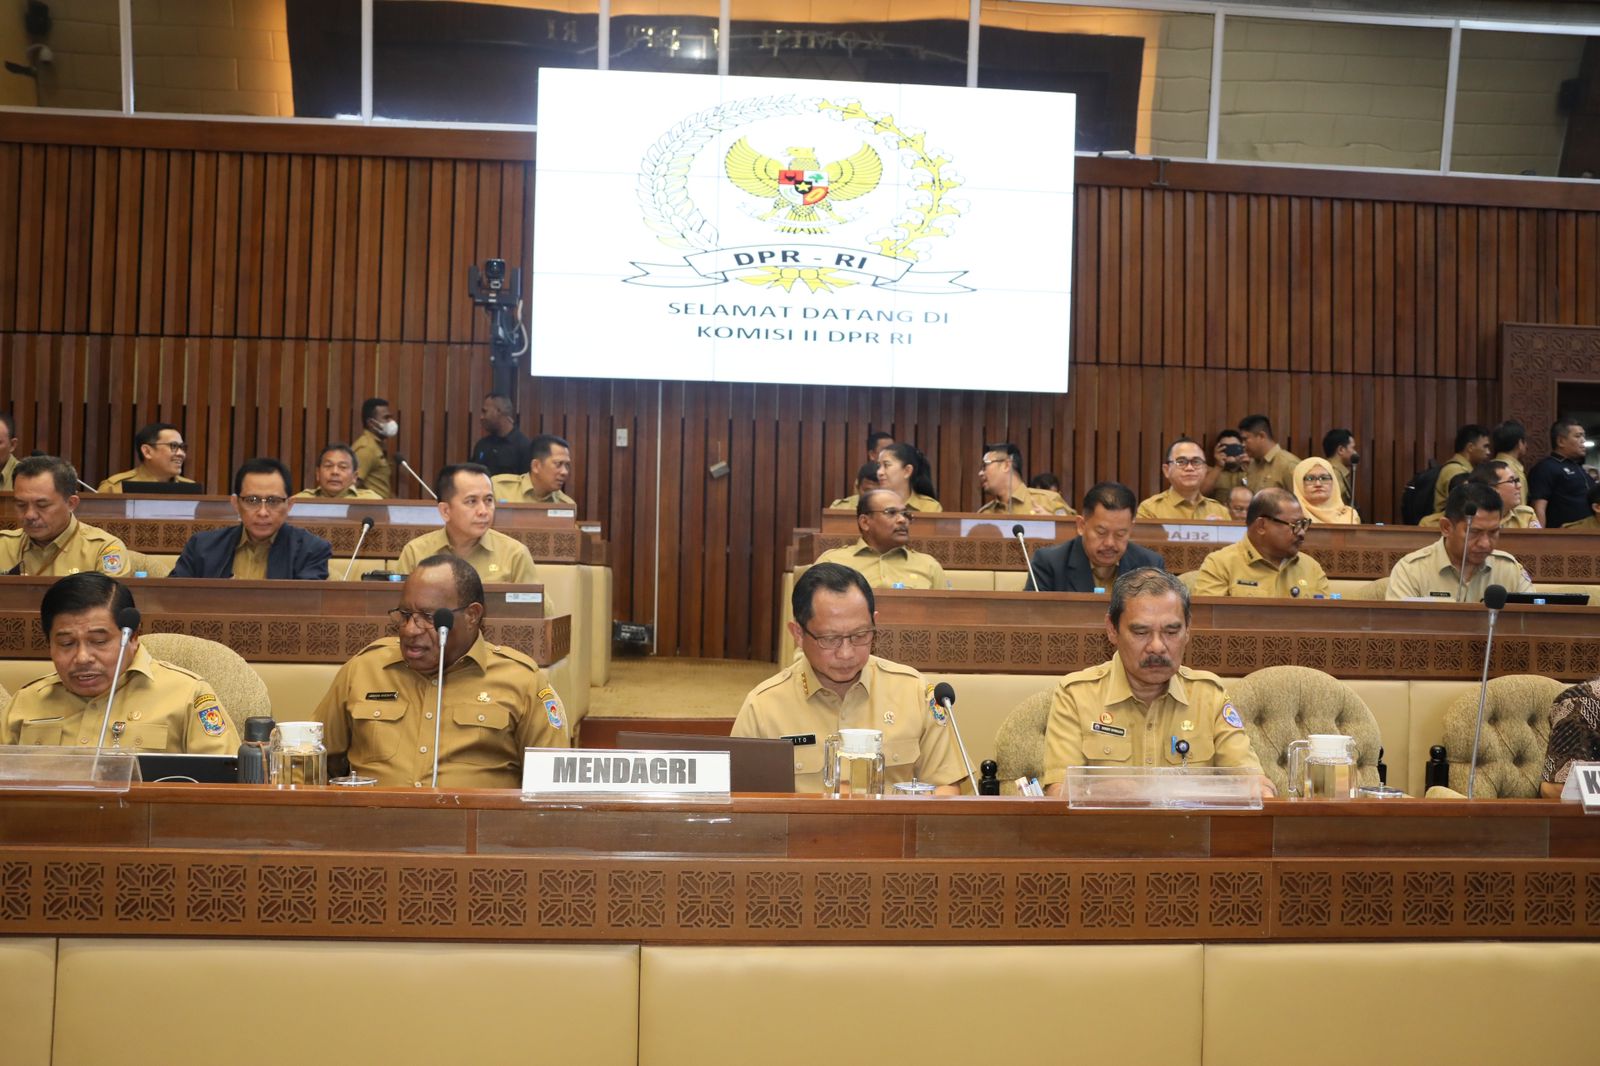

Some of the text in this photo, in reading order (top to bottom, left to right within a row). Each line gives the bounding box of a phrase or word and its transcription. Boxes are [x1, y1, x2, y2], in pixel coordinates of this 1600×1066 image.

[734, 250, 800, 266] DPR
[835, 253, 867, 269] RI
[668, 302, 949, 324] SELAMAT DATANG DI
[697, 325, 913, 345] KOMISI II DPR RI
[553, 757, 697, 784] MENDAGRI
[1583, 770, 1600, 794] K
